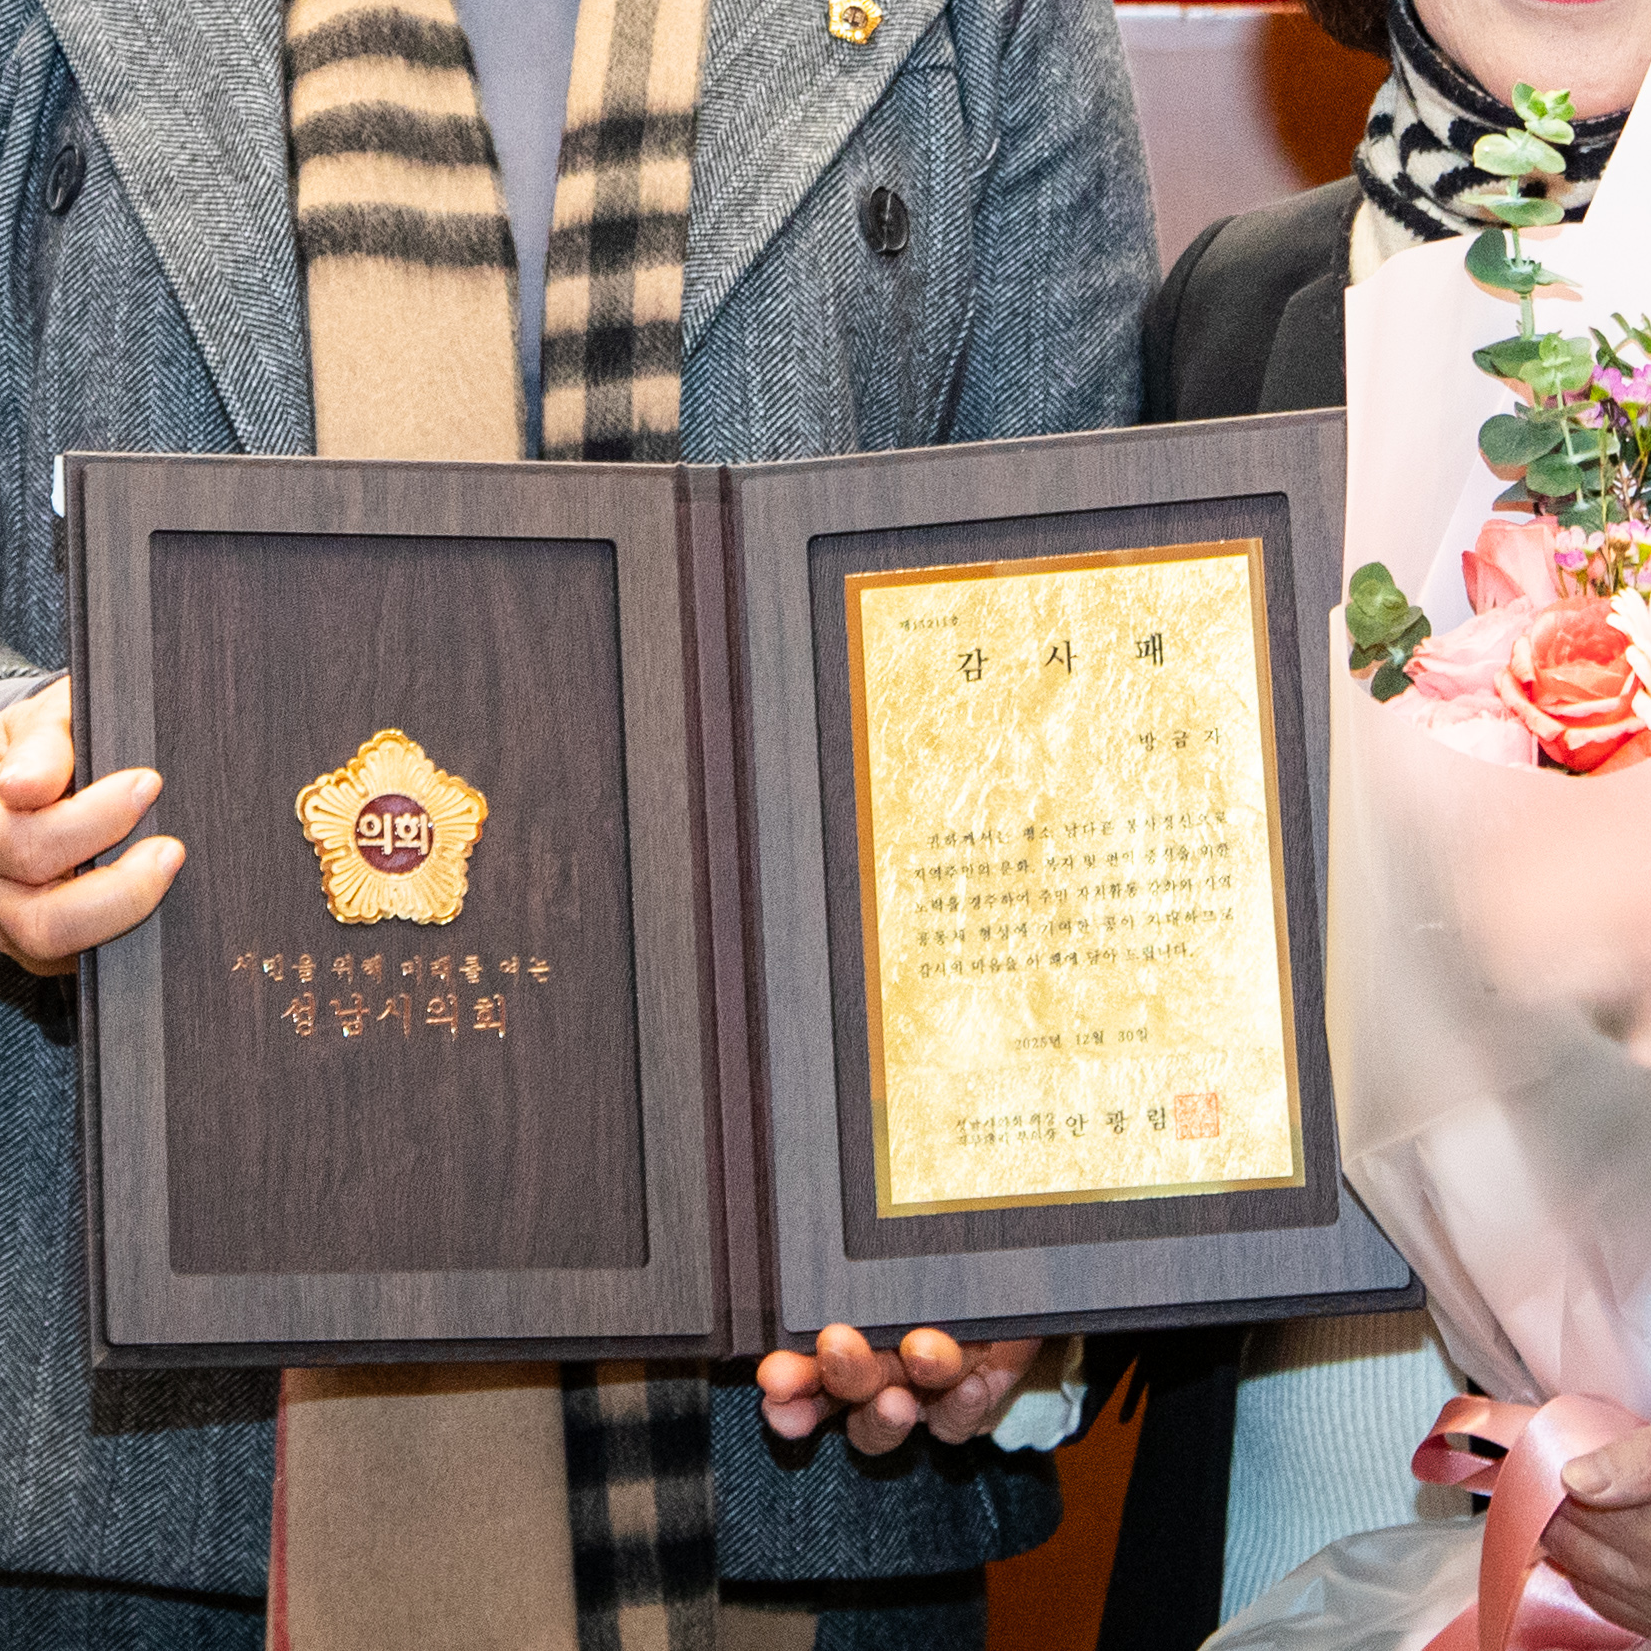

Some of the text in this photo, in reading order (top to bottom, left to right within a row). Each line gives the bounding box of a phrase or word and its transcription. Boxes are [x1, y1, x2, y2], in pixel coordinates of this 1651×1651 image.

[358, 812, 429, 856] 의회
[1026, 953, 1039, 970] 이
[281, 992, 506, 1041] 성남시의회
[1075, 1030, 1104, 1046] 12월
[1117, 1026, 1148, 1043] 30일
